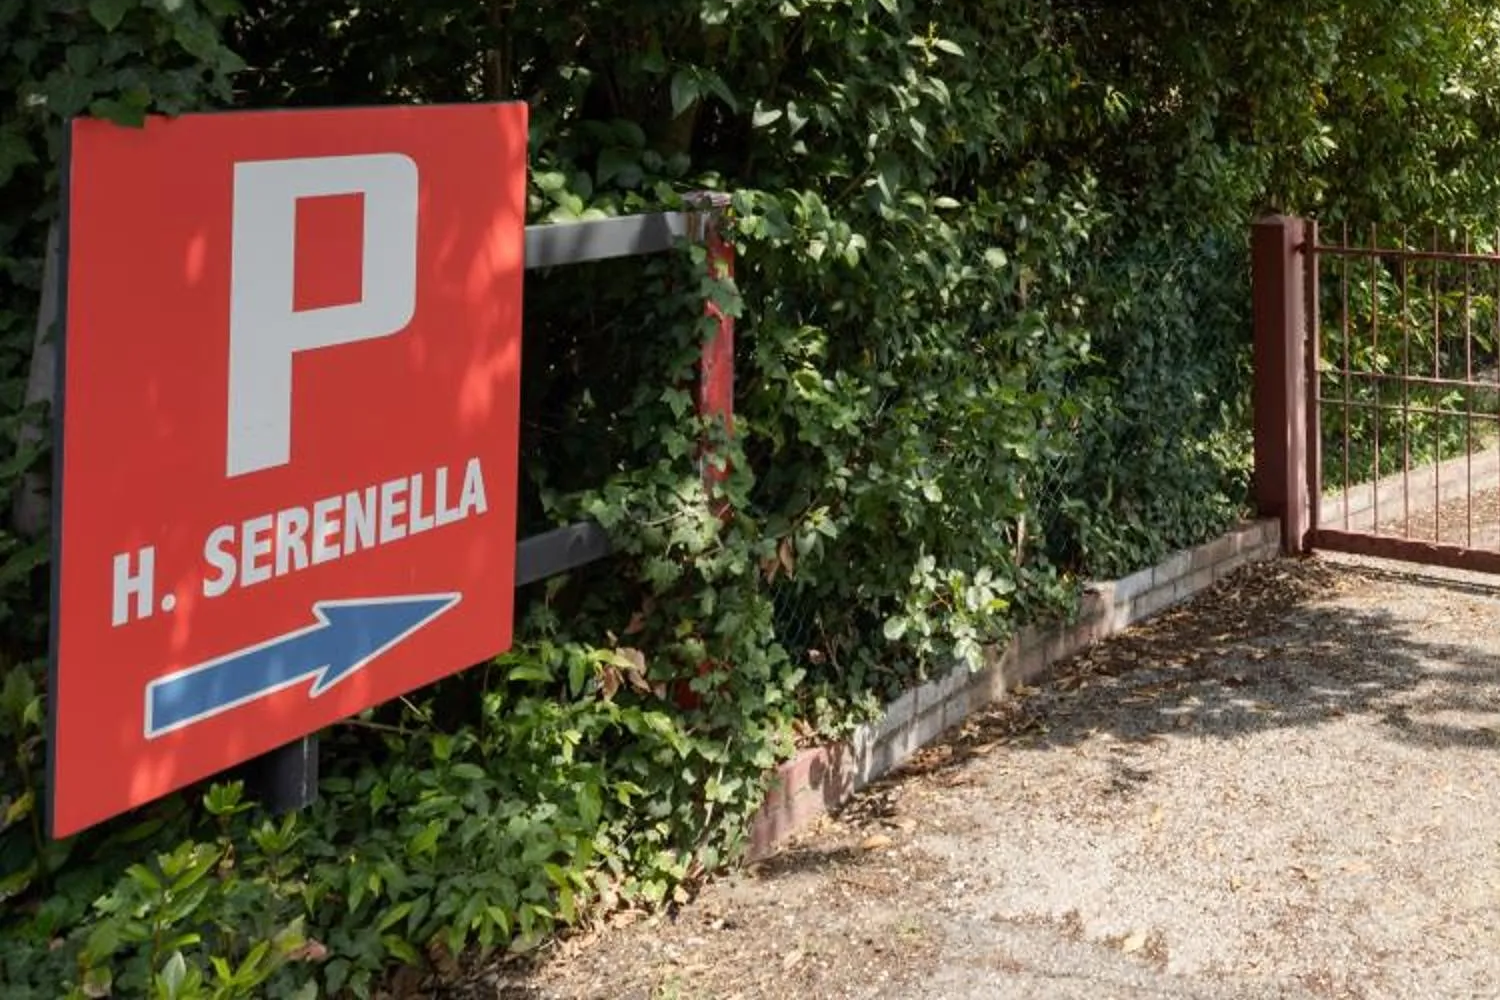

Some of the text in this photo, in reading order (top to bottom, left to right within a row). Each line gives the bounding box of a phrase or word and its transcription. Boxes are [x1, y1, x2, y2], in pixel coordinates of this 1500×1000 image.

[227, 153, 419, 478] P
[112, 457, 488, 627] H. SERENELLA
